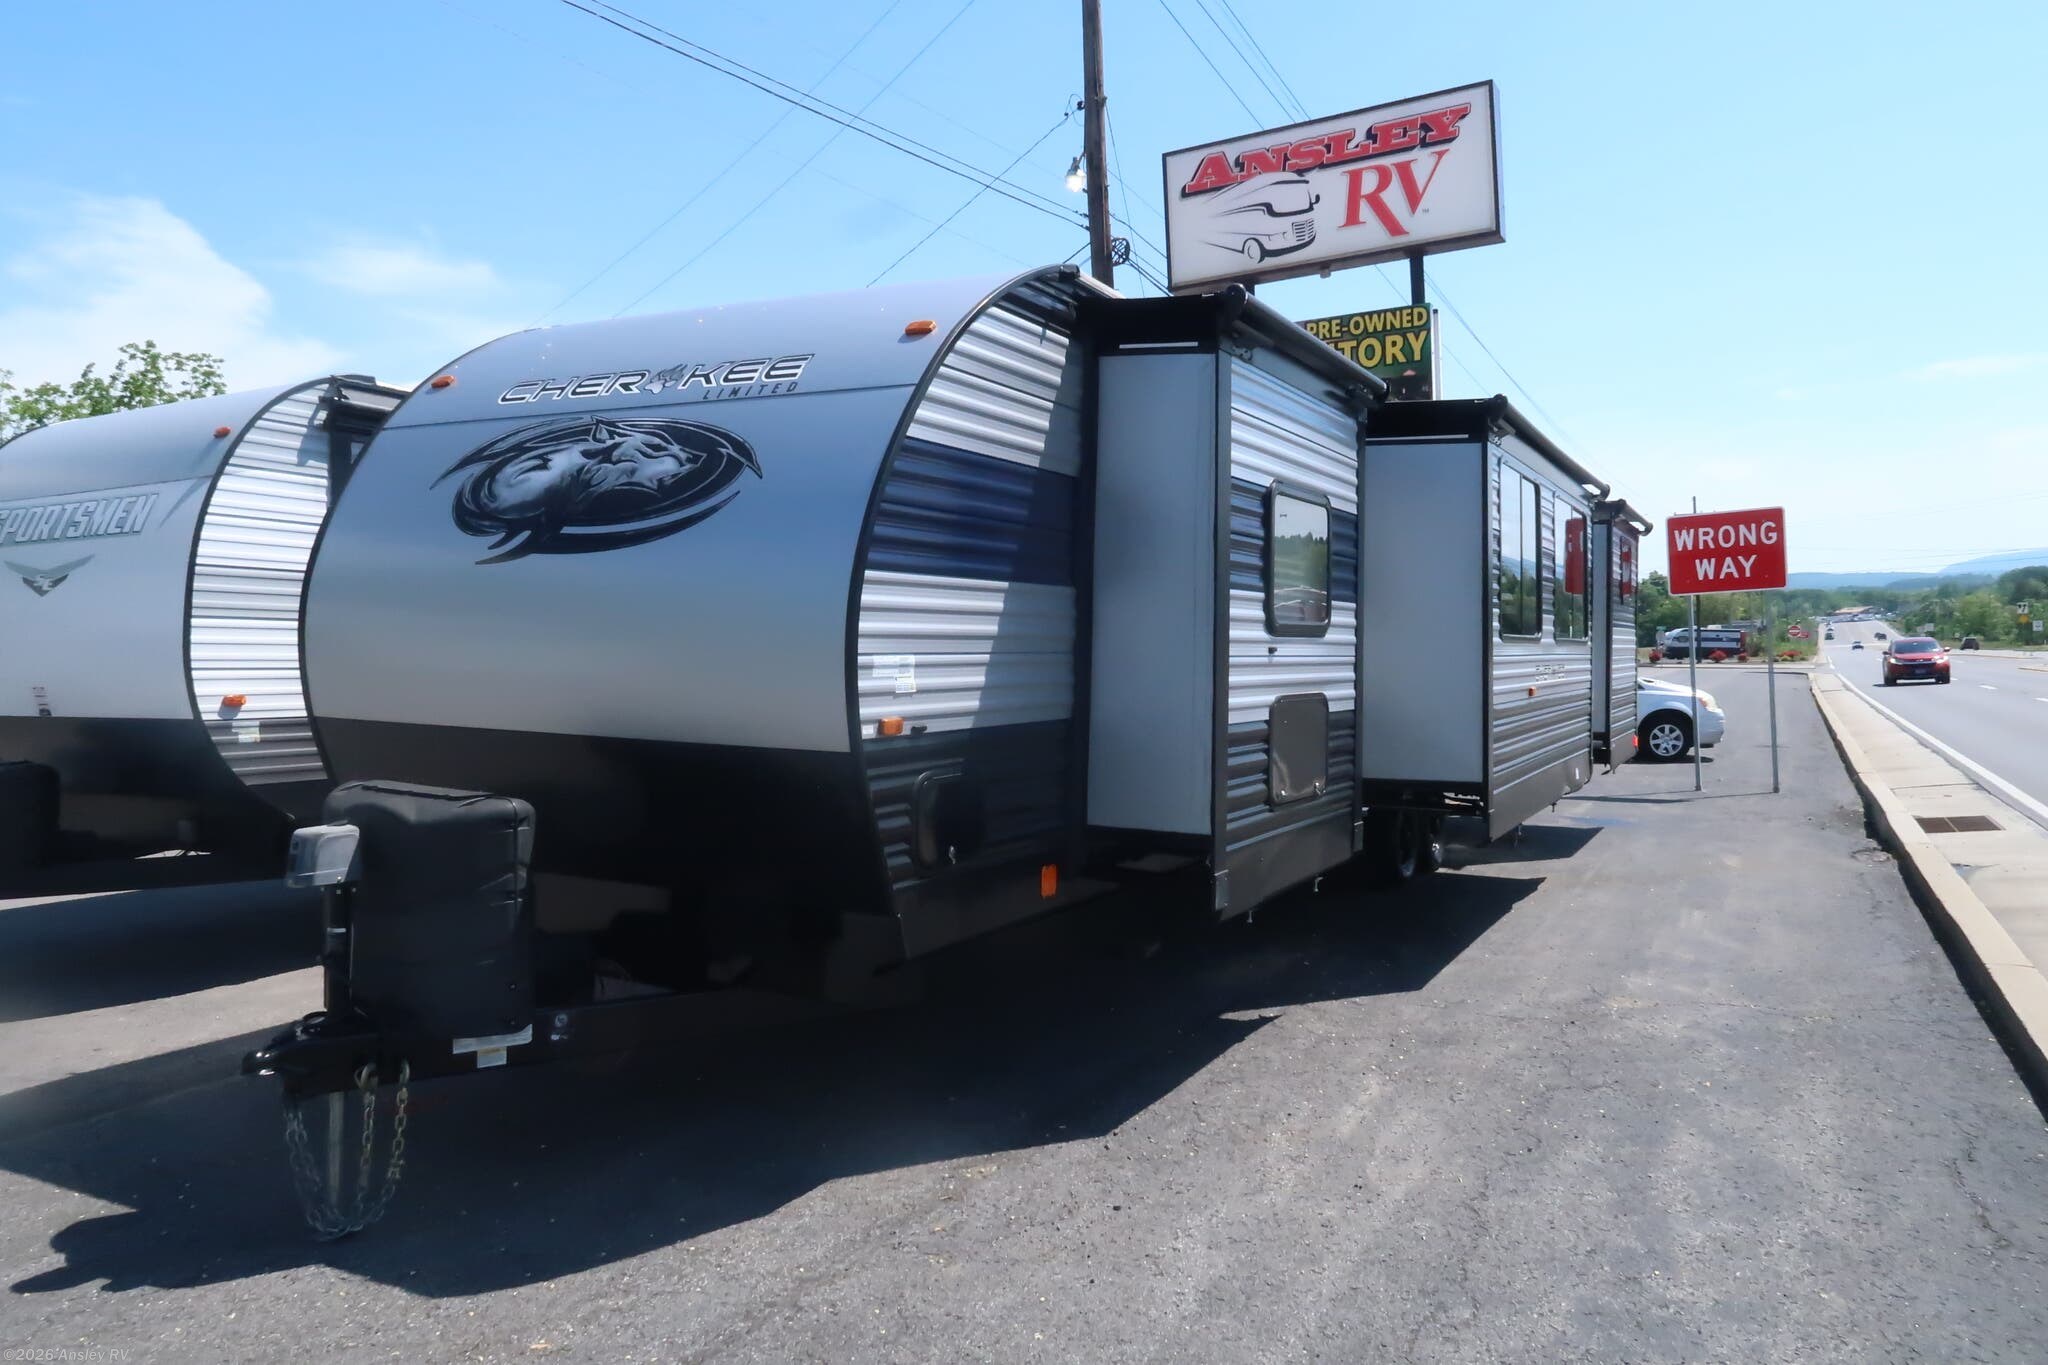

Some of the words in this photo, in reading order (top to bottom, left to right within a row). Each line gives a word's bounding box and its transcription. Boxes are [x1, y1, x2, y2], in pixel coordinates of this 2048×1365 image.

[1181, 103, 1471, 198] ANSLEY
[1338, 148, 1450, 237] RV
[1306, 307, 1428, 339] PRE-OWNED
[1327, 330, 1428, 368] TORY
[702, 381, 798, 400] LIMITED
[1673, 521, 1778, 551] WRONG
[1694, 554, 1757, 581] WAY
